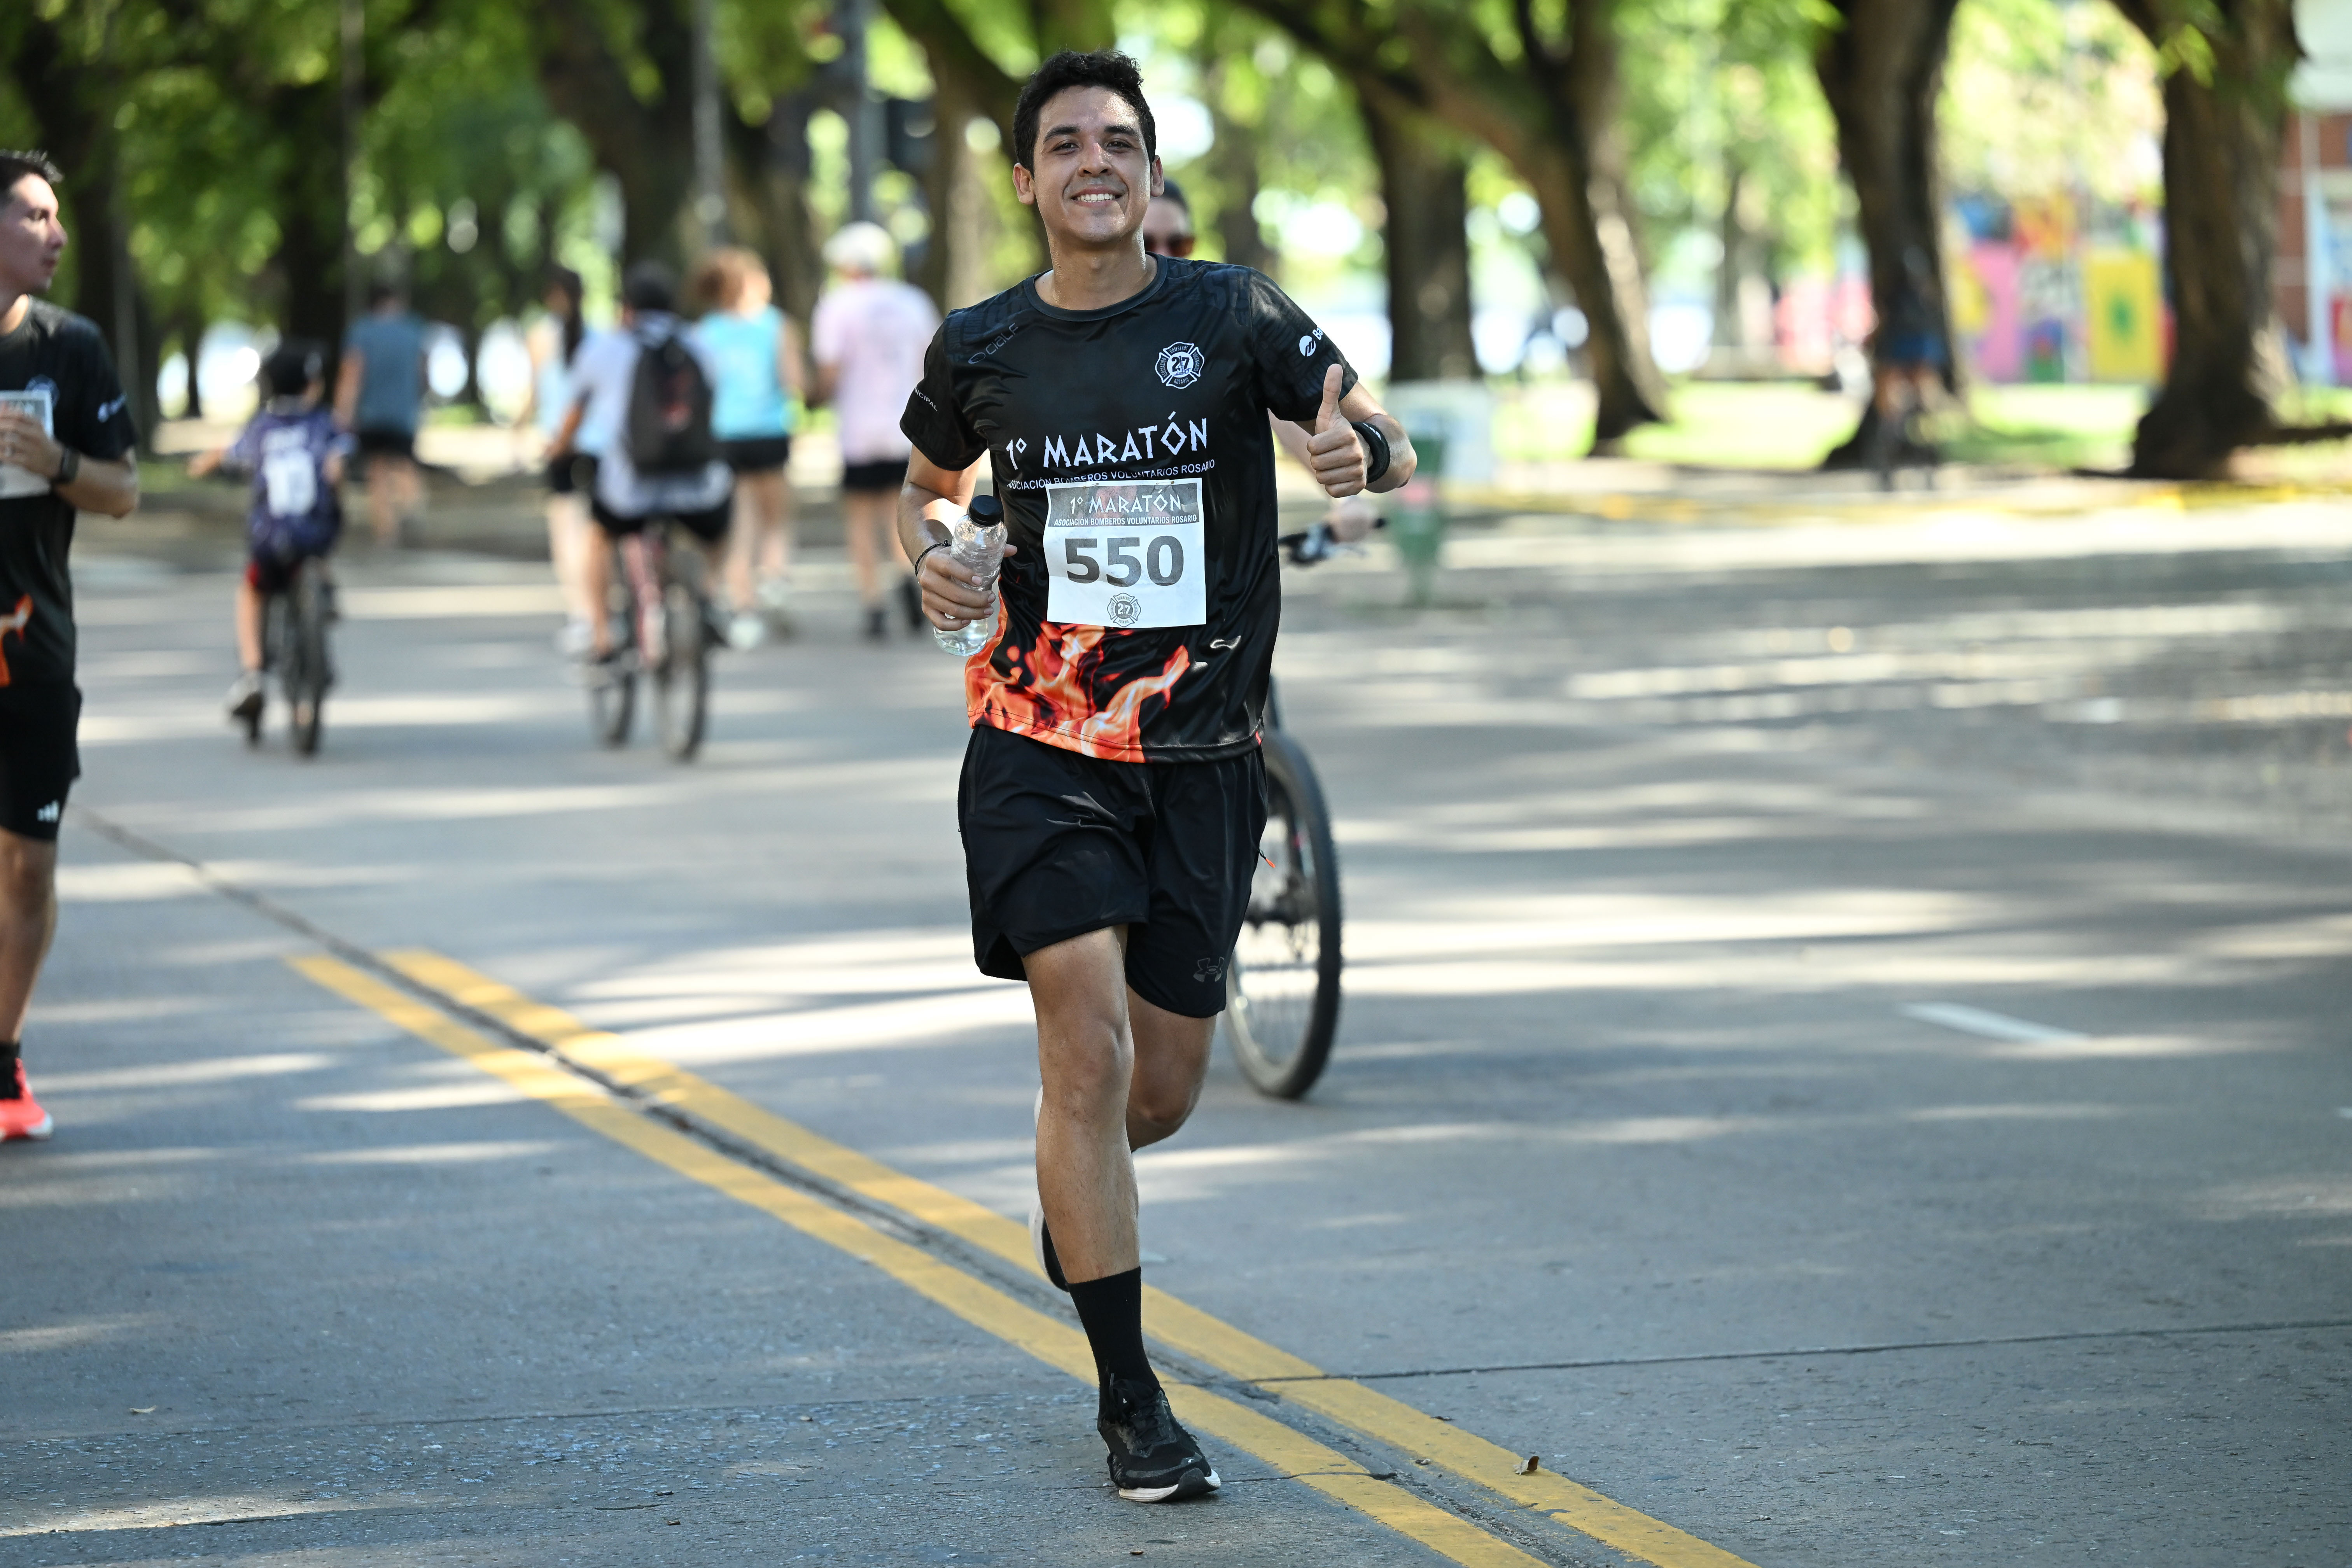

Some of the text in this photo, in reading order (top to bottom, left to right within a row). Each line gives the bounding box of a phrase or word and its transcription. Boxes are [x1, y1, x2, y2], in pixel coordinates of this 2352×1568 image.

[1169, 345, 1189, 354] BOMBEROS
[1171, 356, 1190, 372] 27
[1043, 411, 1207, 467] MARATÓN
[1007, 477, 1052, 490] ASOCIACIÓN
[1111, 466, 1178, 479] VOLUNTARIOS
[1181, 459, 1215, 474] ROSARIO
[1088, 489, 1181, 514] MARATÓN
[1054, 516, 1089, 526] ASOCIACIÓN
[1127, 516, 1170, 525] VOLUNTARIOS
[1171, 514, 1197, 524] ROSARIO
[1065, 536, 1184, 588] 550
[1118, 603, 1130, 614] 27
